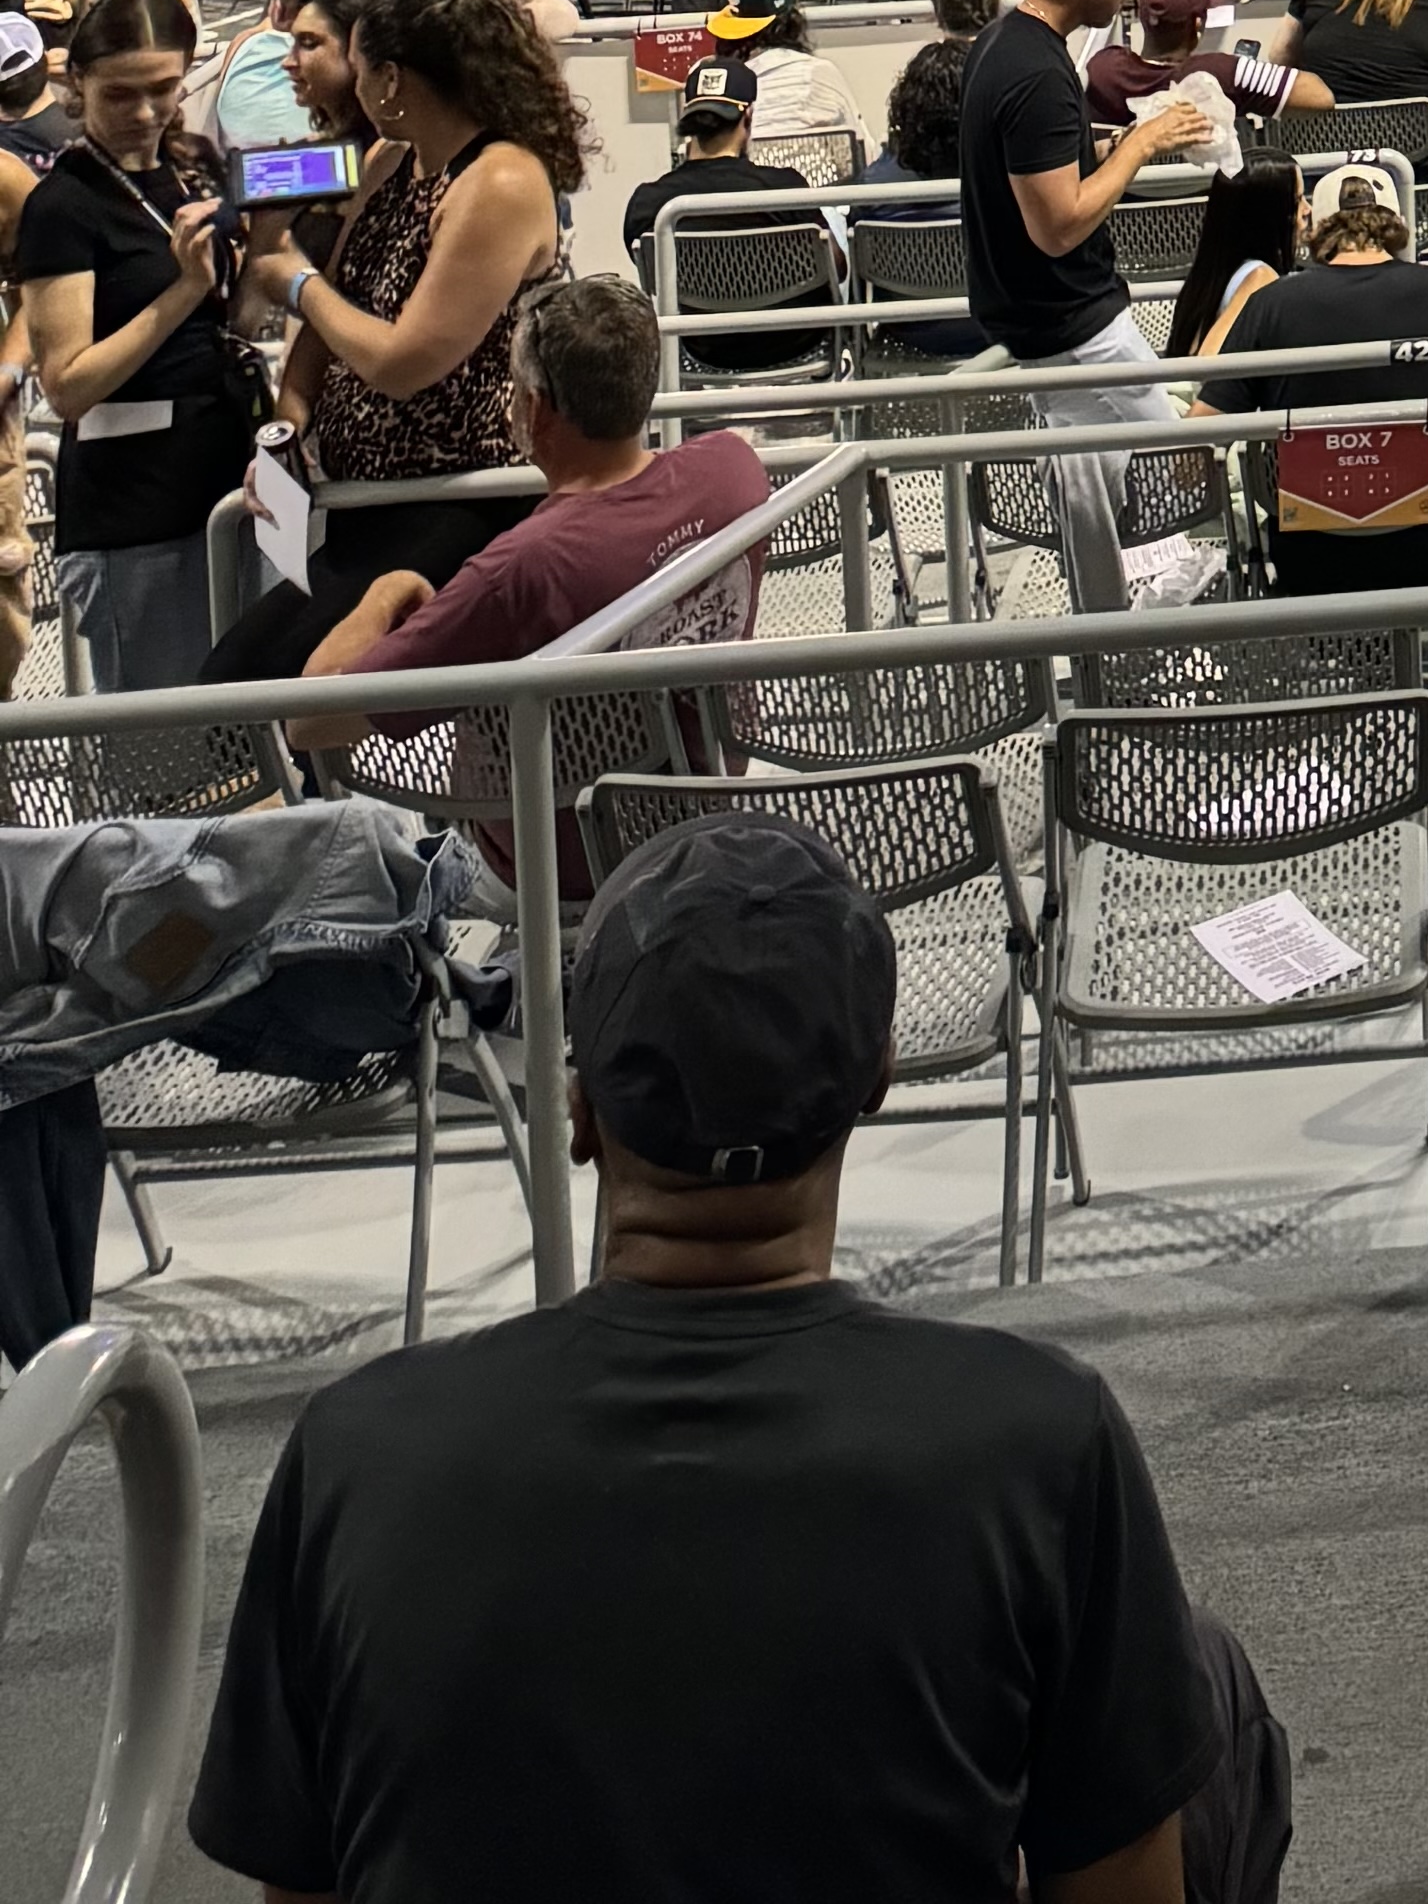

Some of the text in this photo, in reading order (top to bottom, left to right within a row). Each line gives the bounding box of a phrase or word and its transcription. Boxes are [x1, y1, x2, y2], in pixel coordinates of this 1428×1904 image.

[656, 31, 703, 45] BOX 74
[1350, 149, 1377, 163] 73
[1325, 431, 1393, 450] BOX 7
[1337, 454, 1380, 467] SEATS
[646, 518, 705, 567] TOMMY
[659, 589, 727, 645] ROAST
